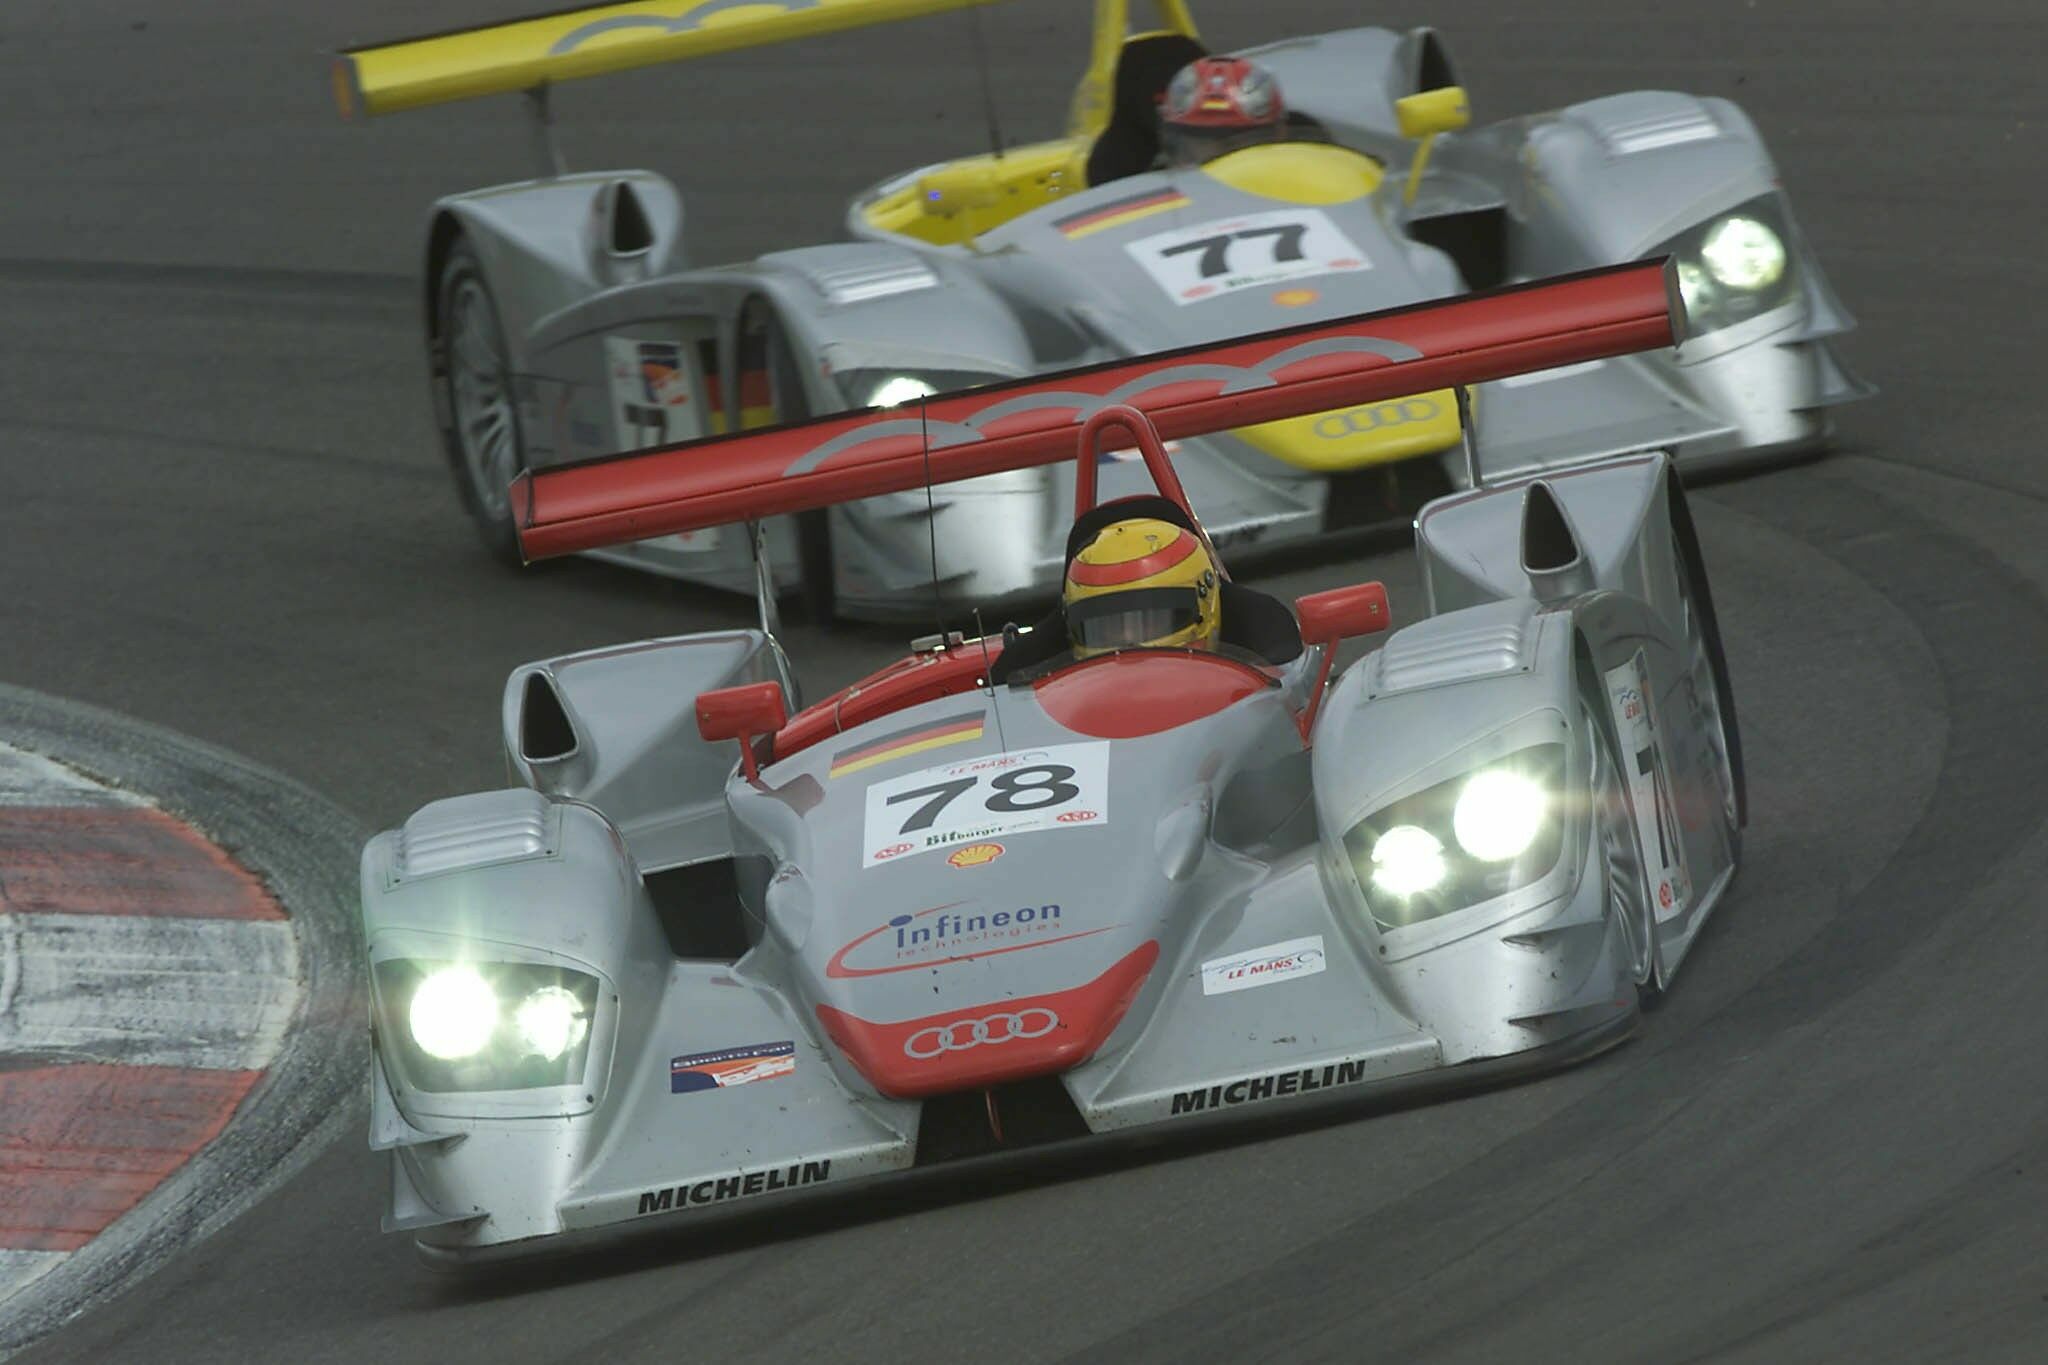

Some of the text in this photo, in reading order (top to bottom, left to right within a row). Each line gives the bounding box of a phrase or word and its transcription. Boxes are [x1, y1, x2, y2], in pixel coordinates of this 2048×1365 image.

[1160, 223, 1309, 278] 77
[886, 764, 1080, 836] 78
[1228, 967, 1244, 979] LE
[1249, 958, 1294, 975] MANS
[1171, 1060, 1366, 1115] MICHELIN
[638, 1159, 831, 1214] MICHELIN
